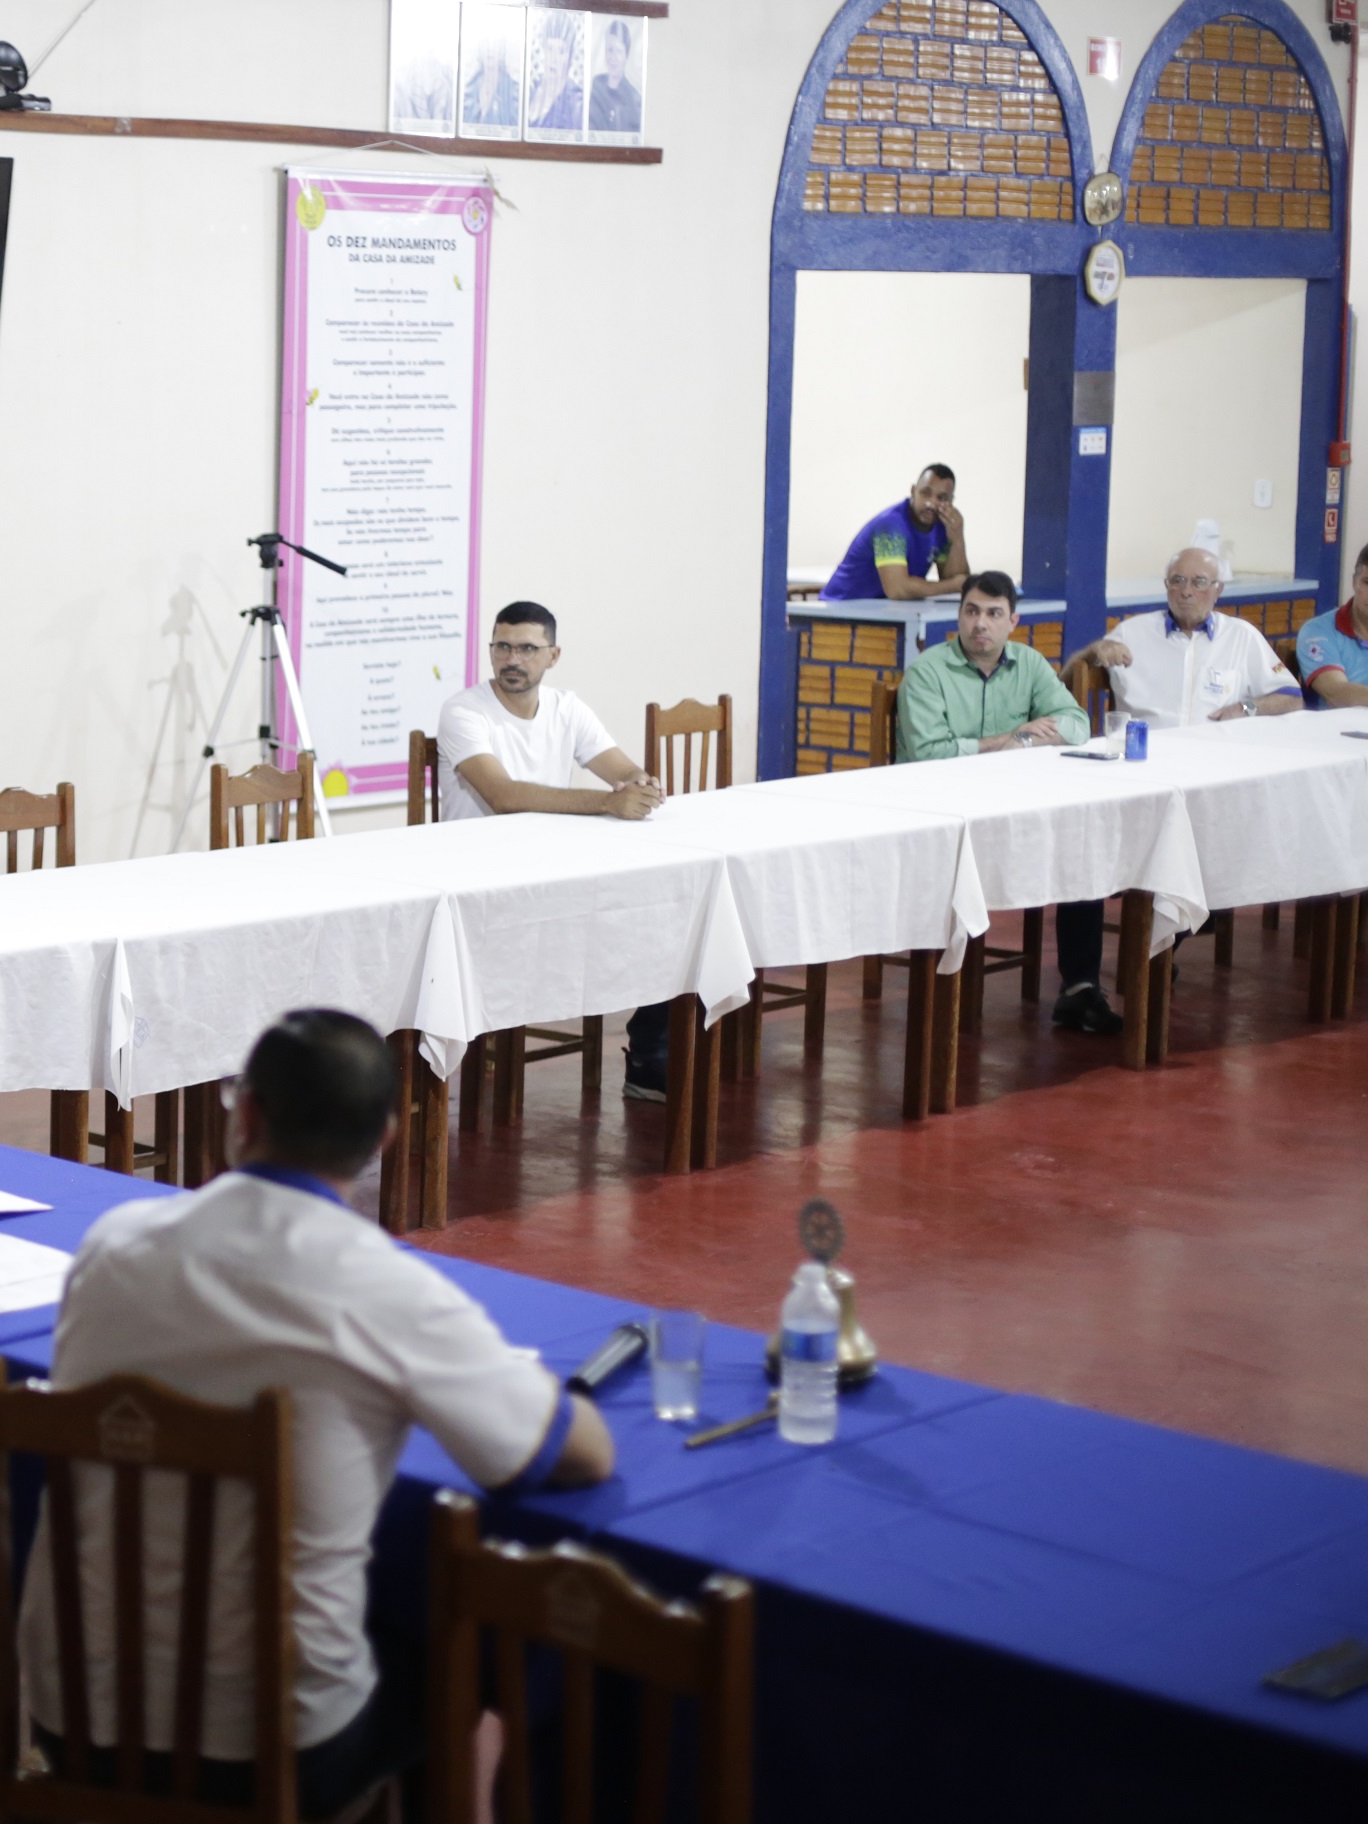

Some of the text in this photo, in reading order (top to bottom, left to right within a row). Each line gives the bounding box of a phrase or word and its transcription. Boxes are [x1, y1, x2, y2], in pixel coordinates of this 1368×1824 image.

[327, 235, 457, 251] OS DEZ MANDAMENTOS
[348, 253, 435, 265] DA CASA DA AMIZADE
